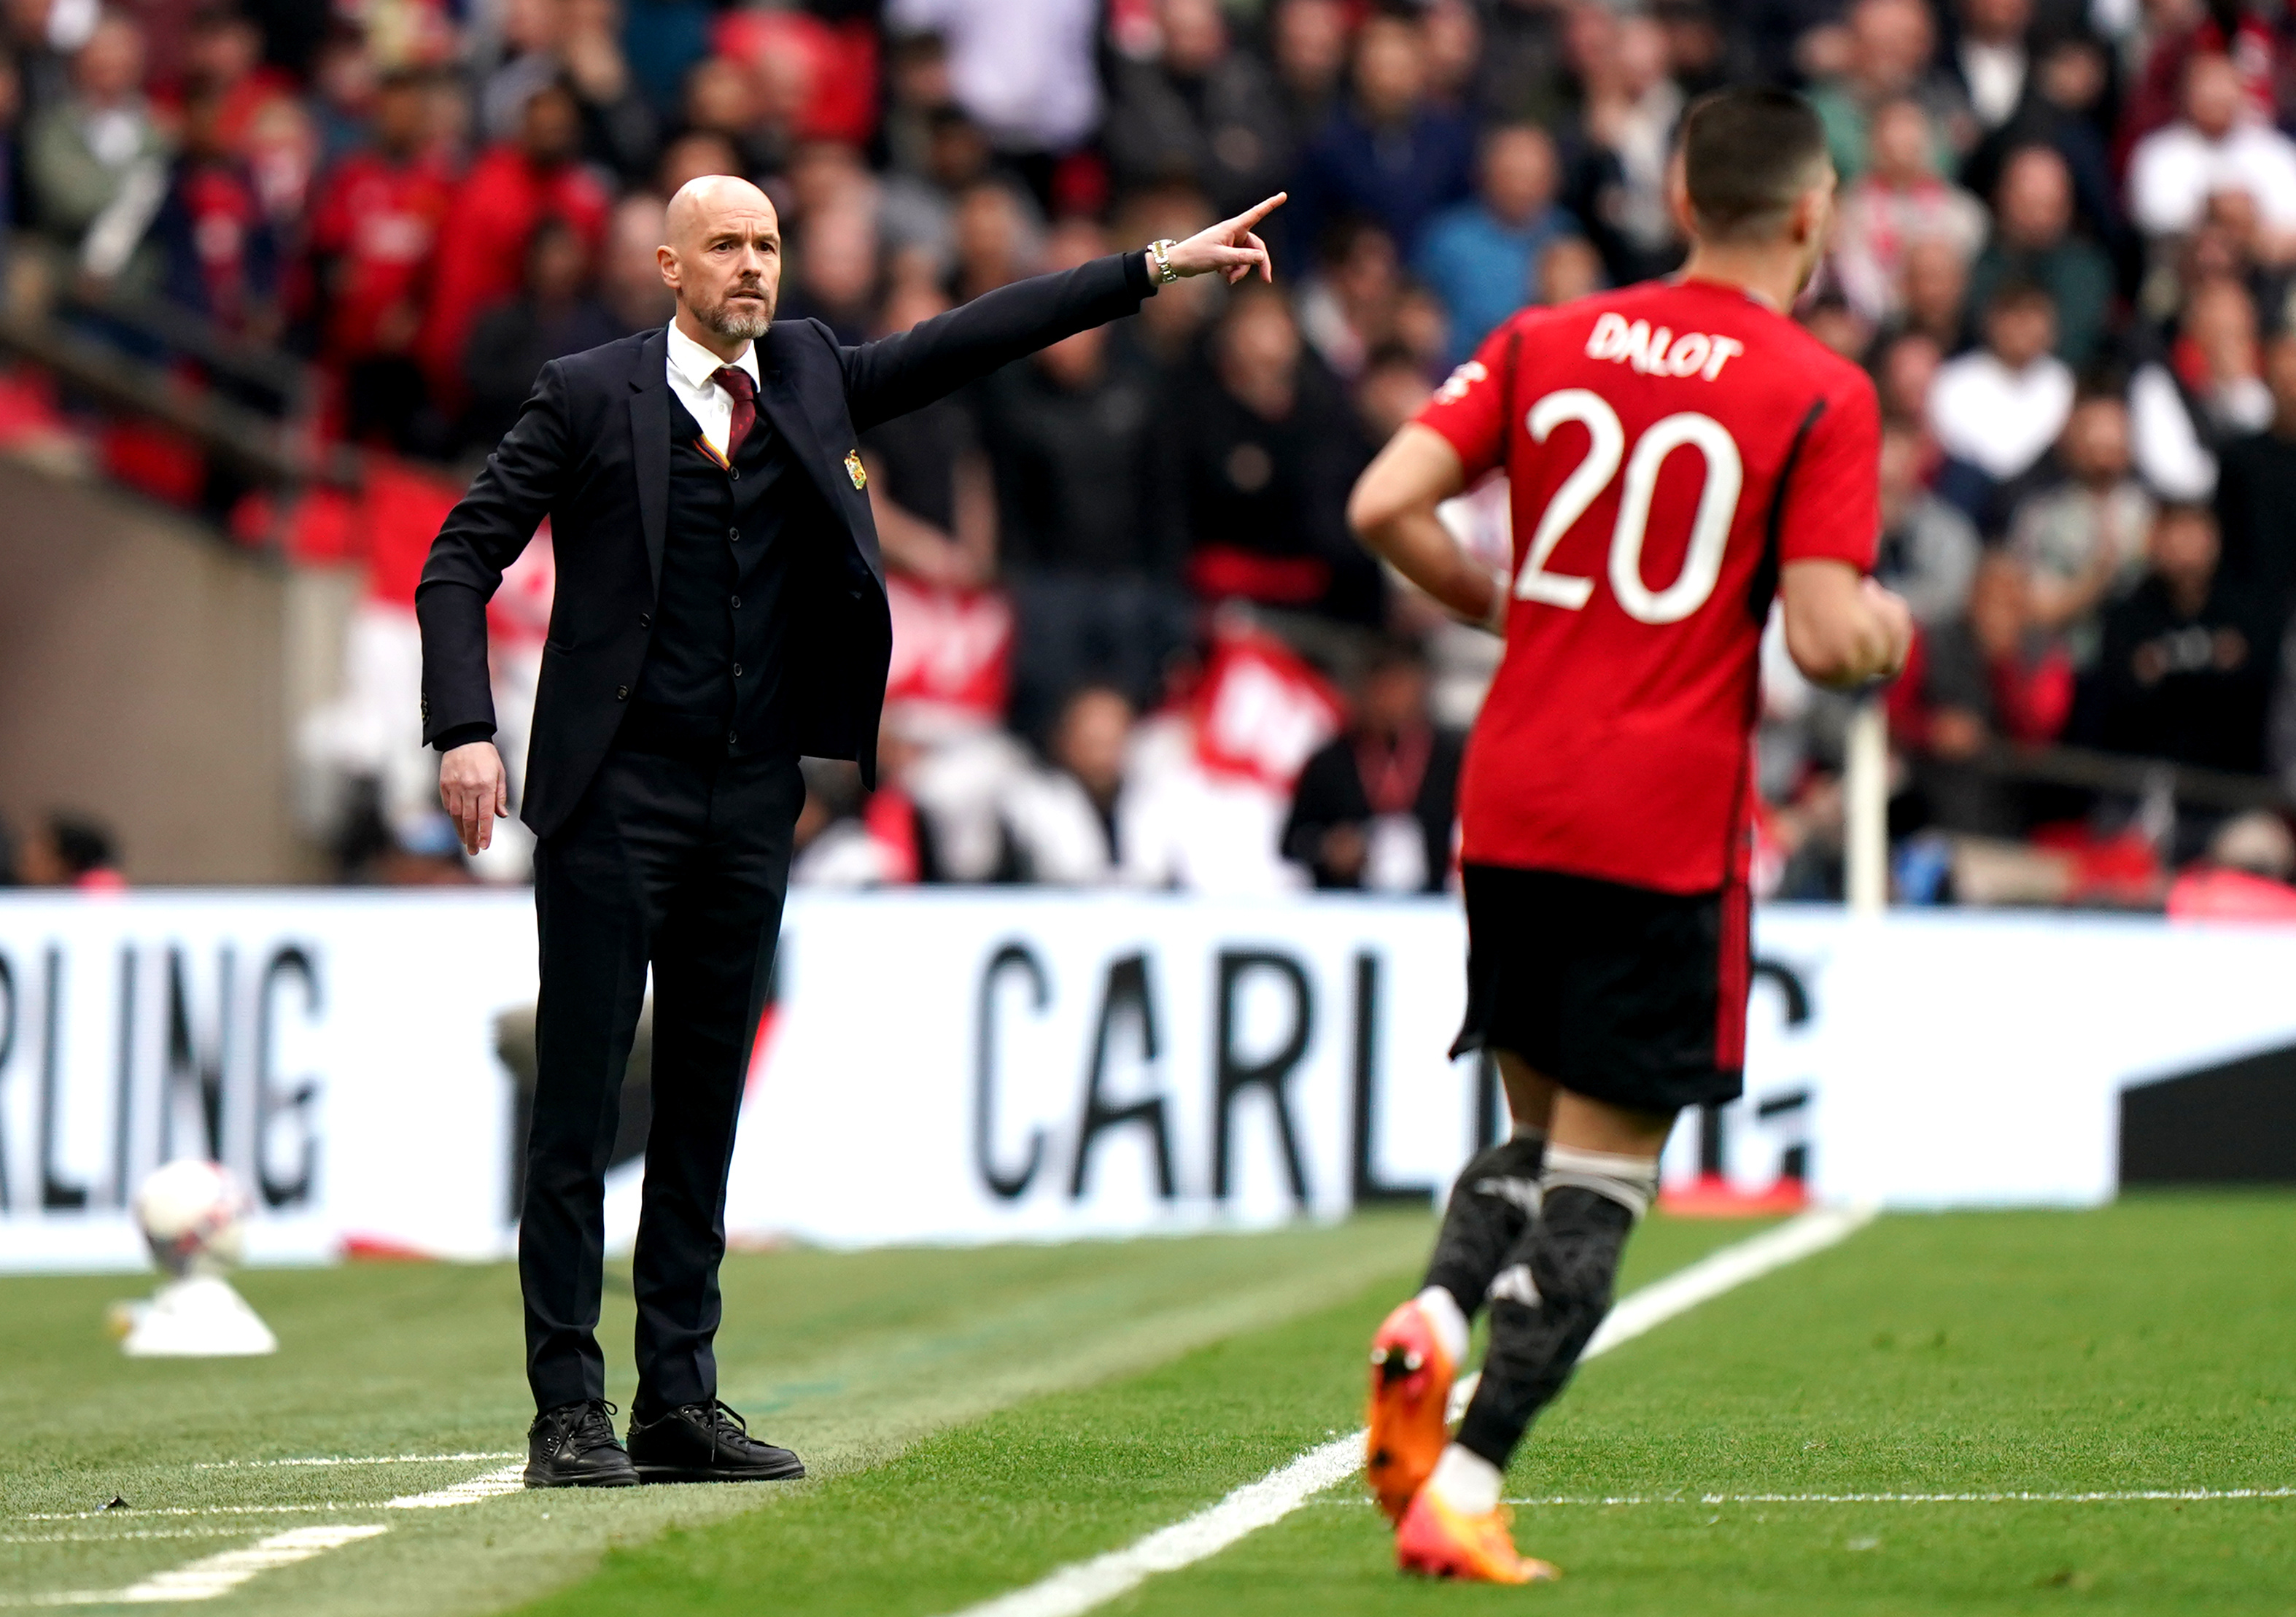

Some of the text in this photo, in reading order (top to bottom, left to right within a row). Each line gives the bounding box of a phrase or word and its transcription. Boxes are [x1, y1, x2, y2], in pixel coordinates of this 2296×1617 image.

[1585, 311, 1745, 382] DALOT
[1513, 388, 1744, 626] 20
[0, 944, 321, 1212] LING
